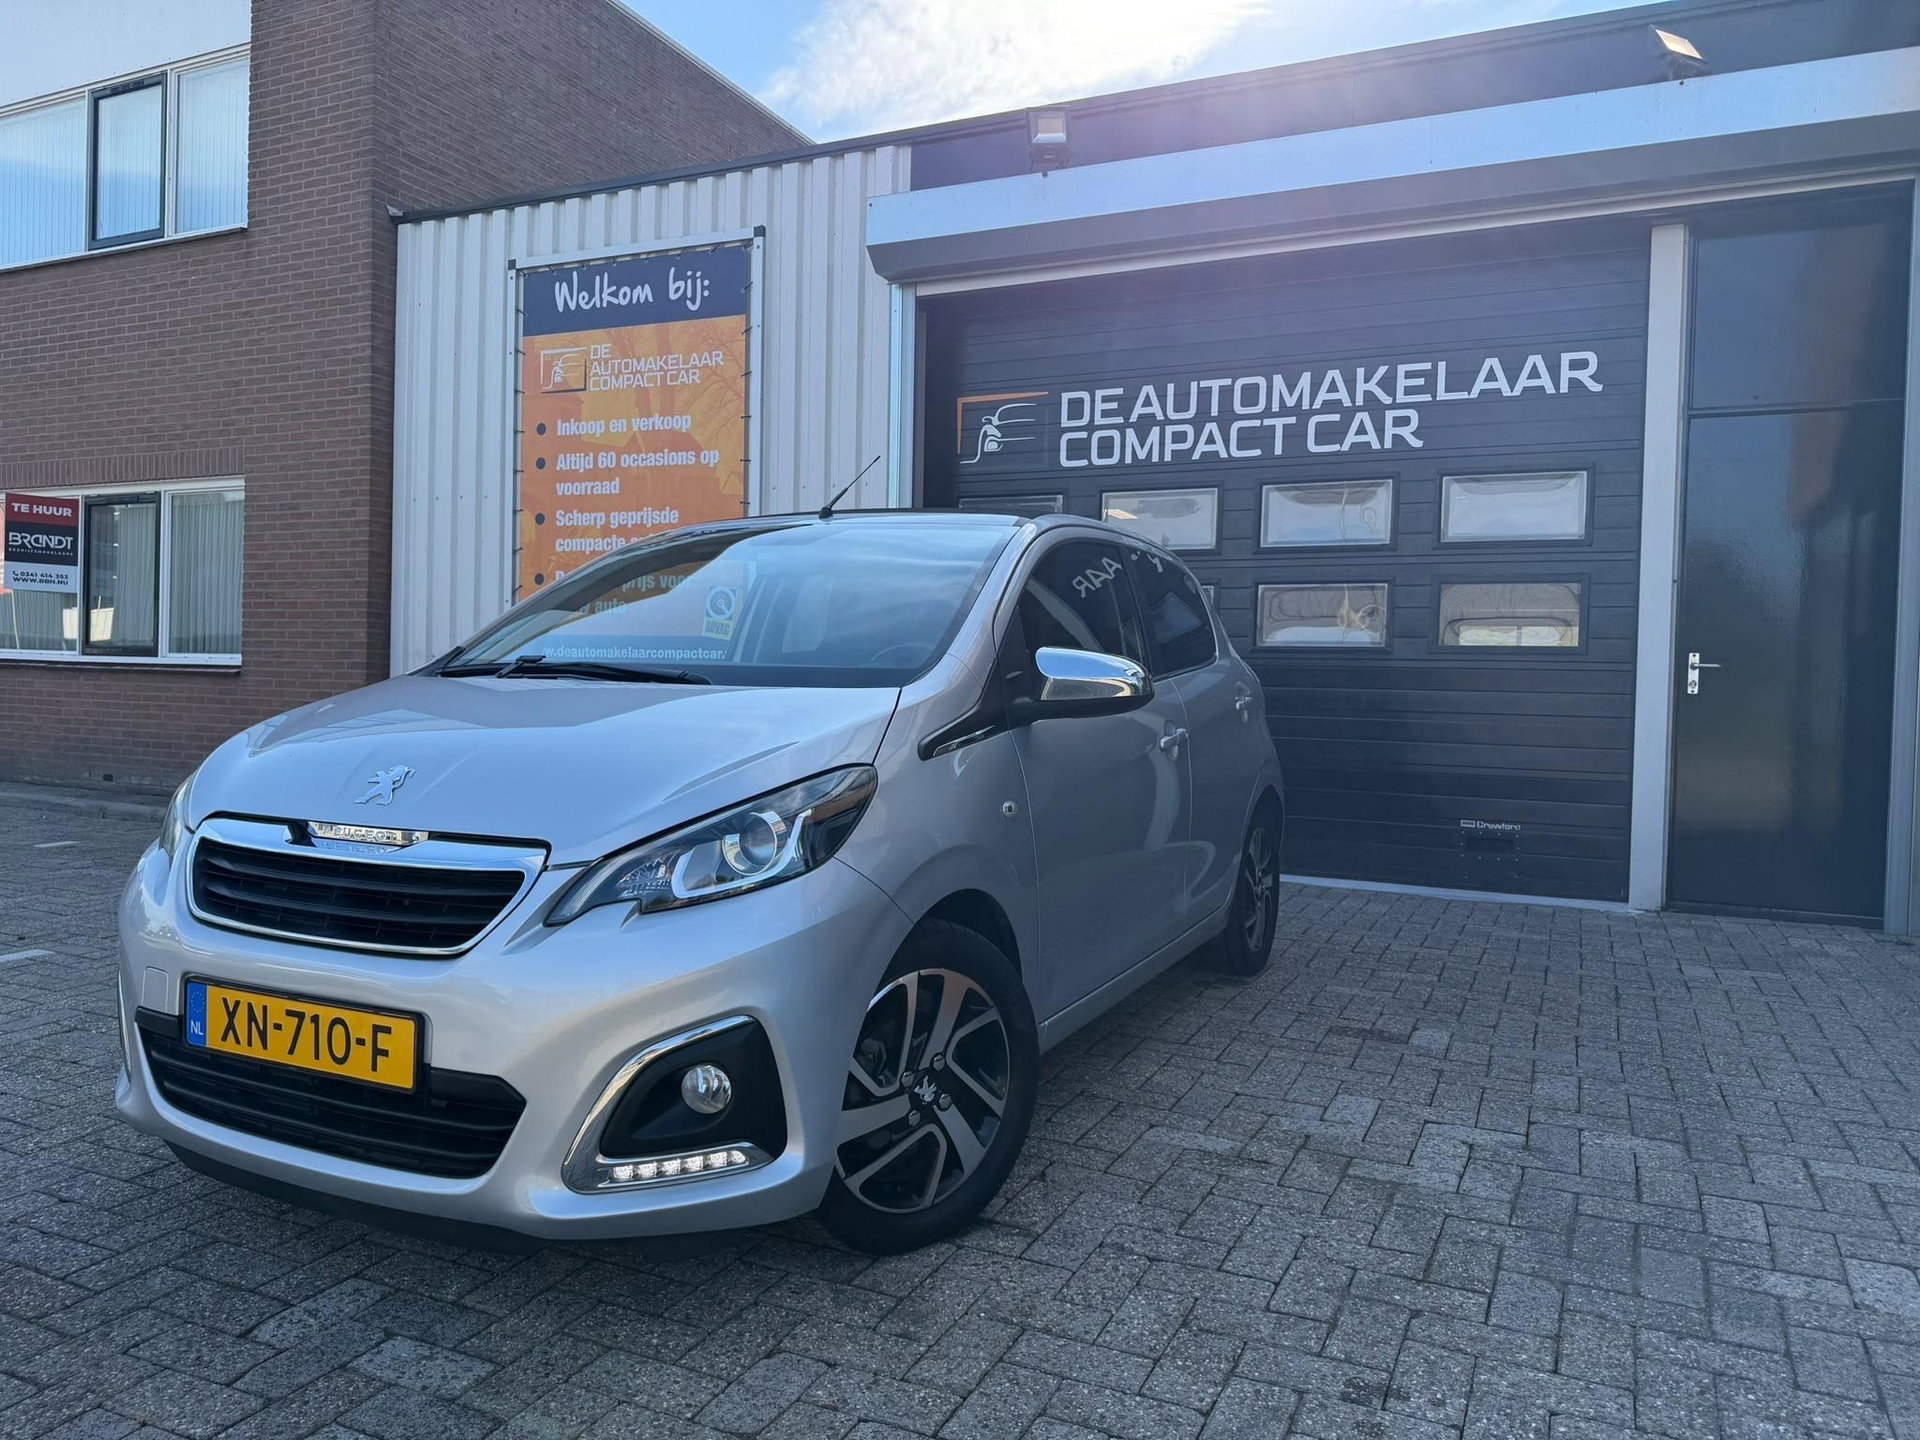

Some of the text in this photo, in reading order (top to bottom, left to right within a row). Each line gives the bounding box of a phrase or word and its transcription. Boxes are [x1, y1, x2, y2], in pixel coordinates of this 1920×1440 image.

[554, 266, 710, 312] Welkom bij:
[590, 344, 612, 360] DE
[590, 351, 725, 376] AUTOMAKELAAR
[590, 369, 702, 392] COMPACT CAR
[1060, 351, 1603, 428] DE AUTOMAKELAAR
[556, 413, 692, 436] Inkoop en verkoop
[1059, 409, 1424, 467] COMPACT CAR
[556, 449, 720, 472] Altijd 60 occasions op
[556, 477, 620, 496] voorraad
[12, 503, 72, 517] TE HUUR
[556, 507, 680, 528] Scherp geprijsde
[9, 532, 74, 550] BRANDT
[556, 534, 626, 555] compacte
[1476, 821, 1521, 831] Crawford
[190, 1020, 204, 1036] NL
[220, 997, 392, 1072] XN-710-F
